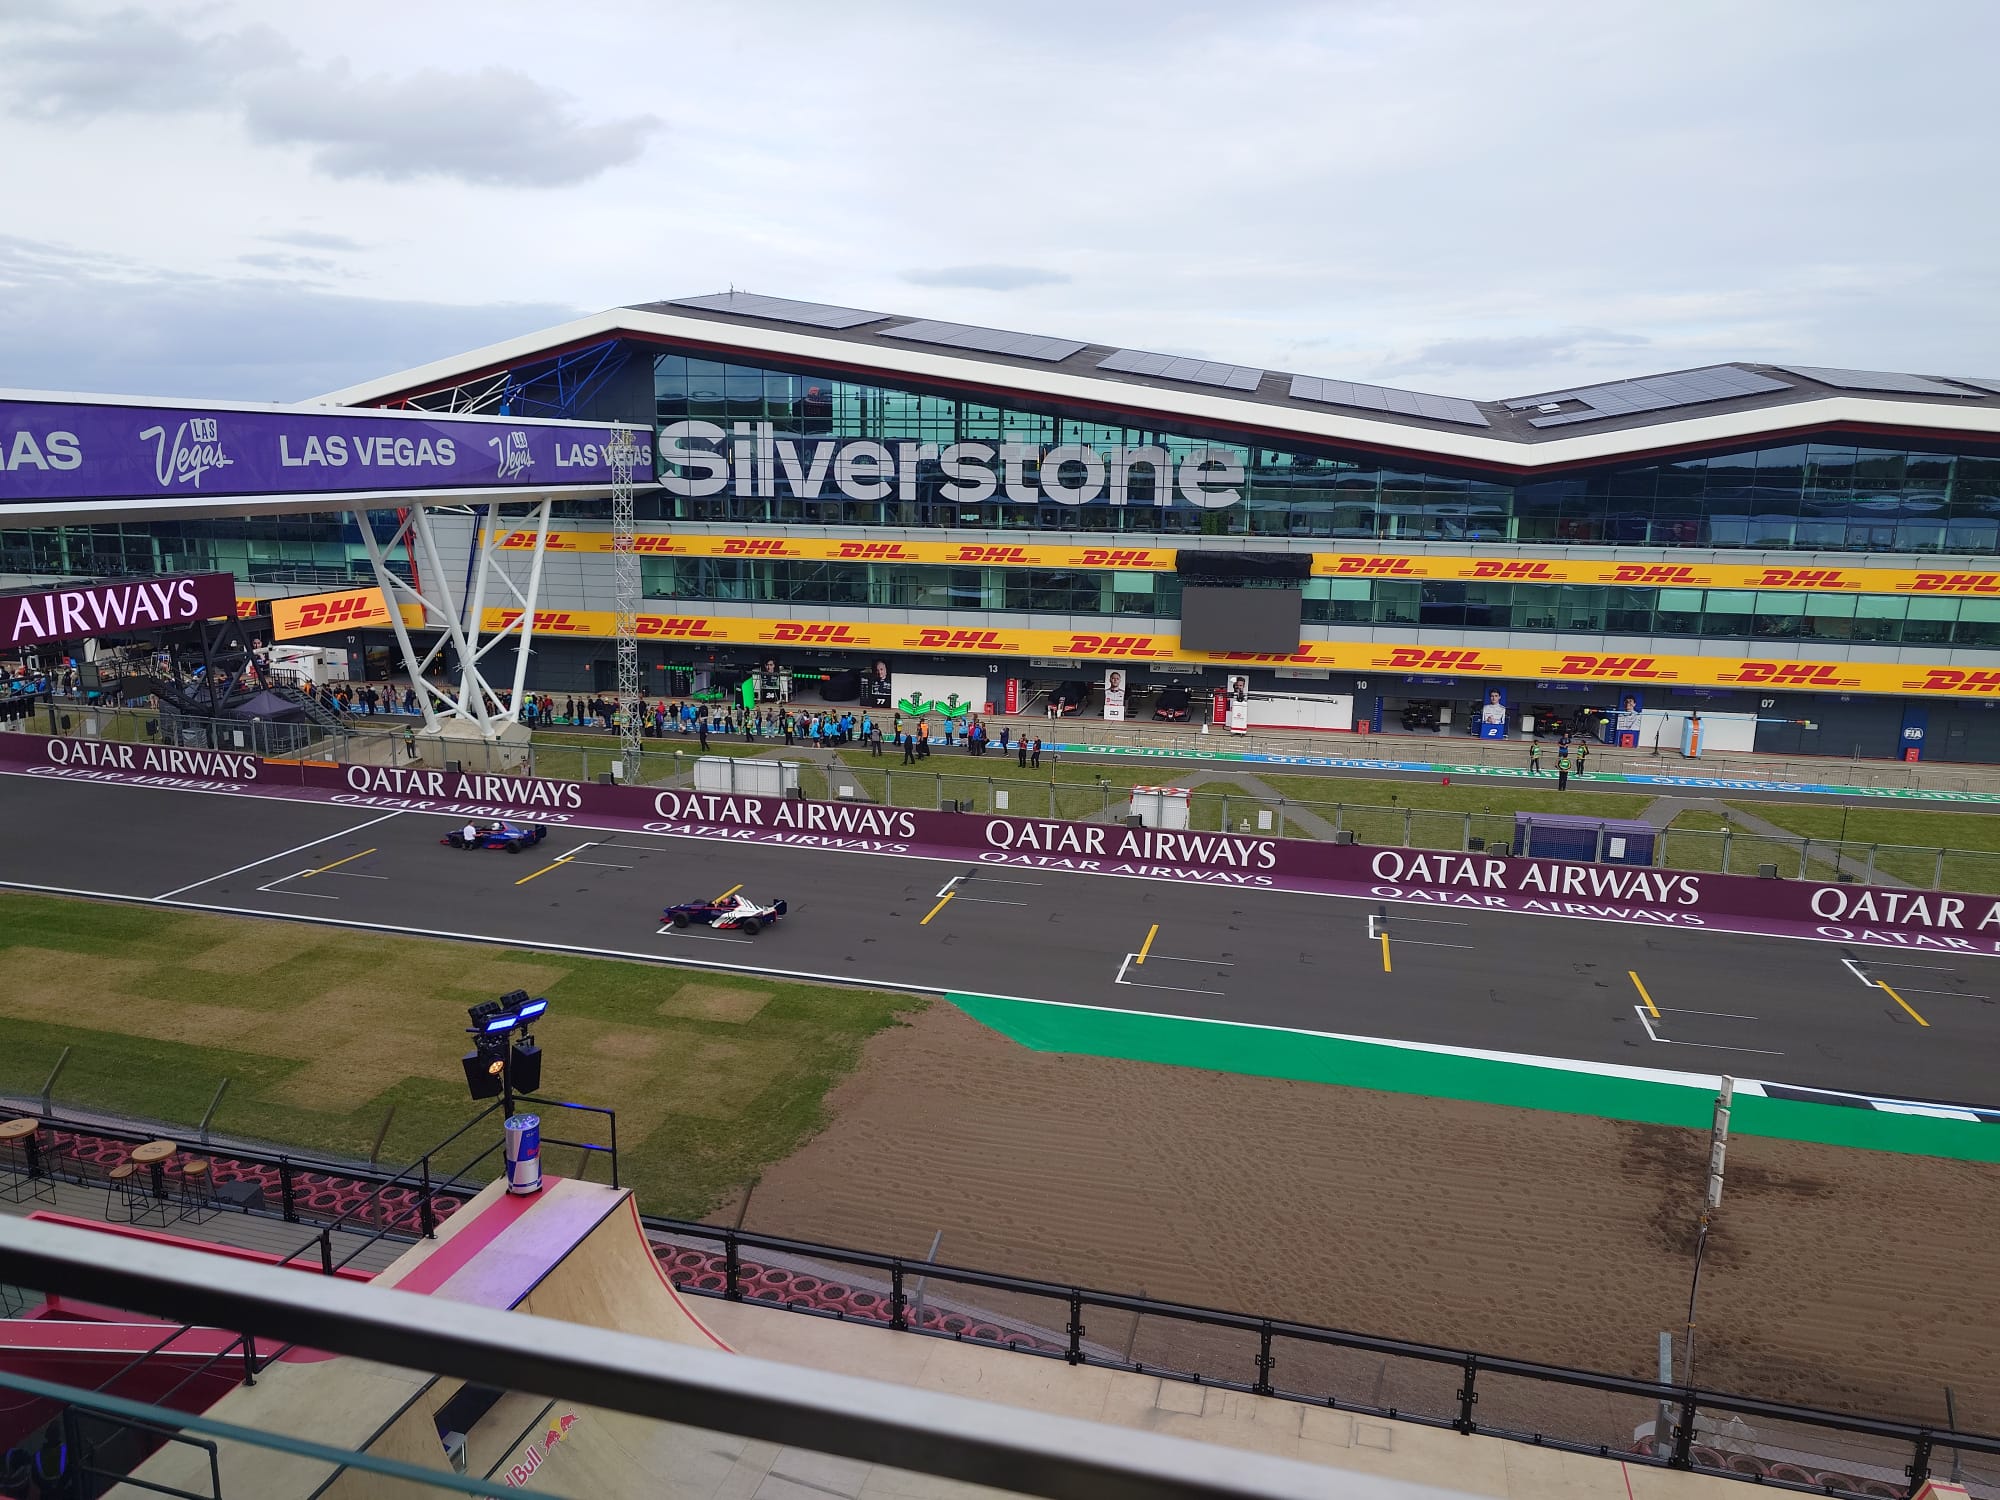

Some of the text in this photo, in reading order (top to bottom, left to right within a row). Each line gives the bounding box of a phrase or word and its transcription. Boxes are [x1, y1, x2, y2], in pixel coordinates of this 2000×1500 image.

[192, 420, 217, 442] LAS
[0, 431, 82, 471] AS
[140, 425, 234, 488] Vegas
[280, 435, 456, 467] LAS VEGAS
[489, 434, 535, 479] Vegas
[555, 443, 598, 467] LAS
[658, 420, 1245, 508] Silverstone
[504, 533, 564, 548] DHL
[721, 539, 789, 555] DHL
[839, 543, 907, 559] DHL
[958, 546, 1027, 563] DHL
[1082, 550, 1154, 567] DHL
[1337, 557, 1414, 575] DHL
[1472, 561, 1553, 579] DHL
[1614, 565, 1696, 583] DHL
[1758, 569, 1845, 588] DHL
[1912, 573, 2000, 592] DHL
[12, 579, 198, 641] AIRWAYS
[300, 597, 373, 628] DHL
[501, 612, 575, 631] DHL
[635, 617, 713, 637] DHL
[773, 623, 855, 644] DHL
[918, 629, 1004, 650] DHL
[1068, 635, 1157, 656] DHL
[988, 664, 998, 673] 13
[1388, 648, 1485, 670] DHL
[1558, 655, 1660, 678] DHL
[1356, 680, 1368, 690] 10
[1736, 662, 1842, 686] DHL
[1922, 670, 2000, 692] DH
[1761, 699, 1775, 708] 07
[1488, 728, 1498, 736] 2
[1905, 729, 1922, 738] FIA
[48, 739, 257, 779] QATAR AIRWAYS
[26, 766, 249, 792] QATAR AIRWAYS
[347, 765, 582, 808] QATAR AIRWAYS
[330, 794, 574, 822] QATAR AIRWAYS
[654, 792, 916, 838] QATAR AIRWAYS
[642, 822, 910, 853] QATAR AIRWAYS
[985, 819, 1276, 869] QATAR AIRWAYS
[978, 852, 1274, 886] QATAR AIRWAYS
[1371, 851, 1700, 905] QATAR AIRWAYS
[1370, 886, 1705, 925] QATAR AIRWAYS
[1811, 887, 1965, 929] QATAR
[1816, 926, 1980, 950] QATAR
[510, 1445, 543, 1487] Bull
